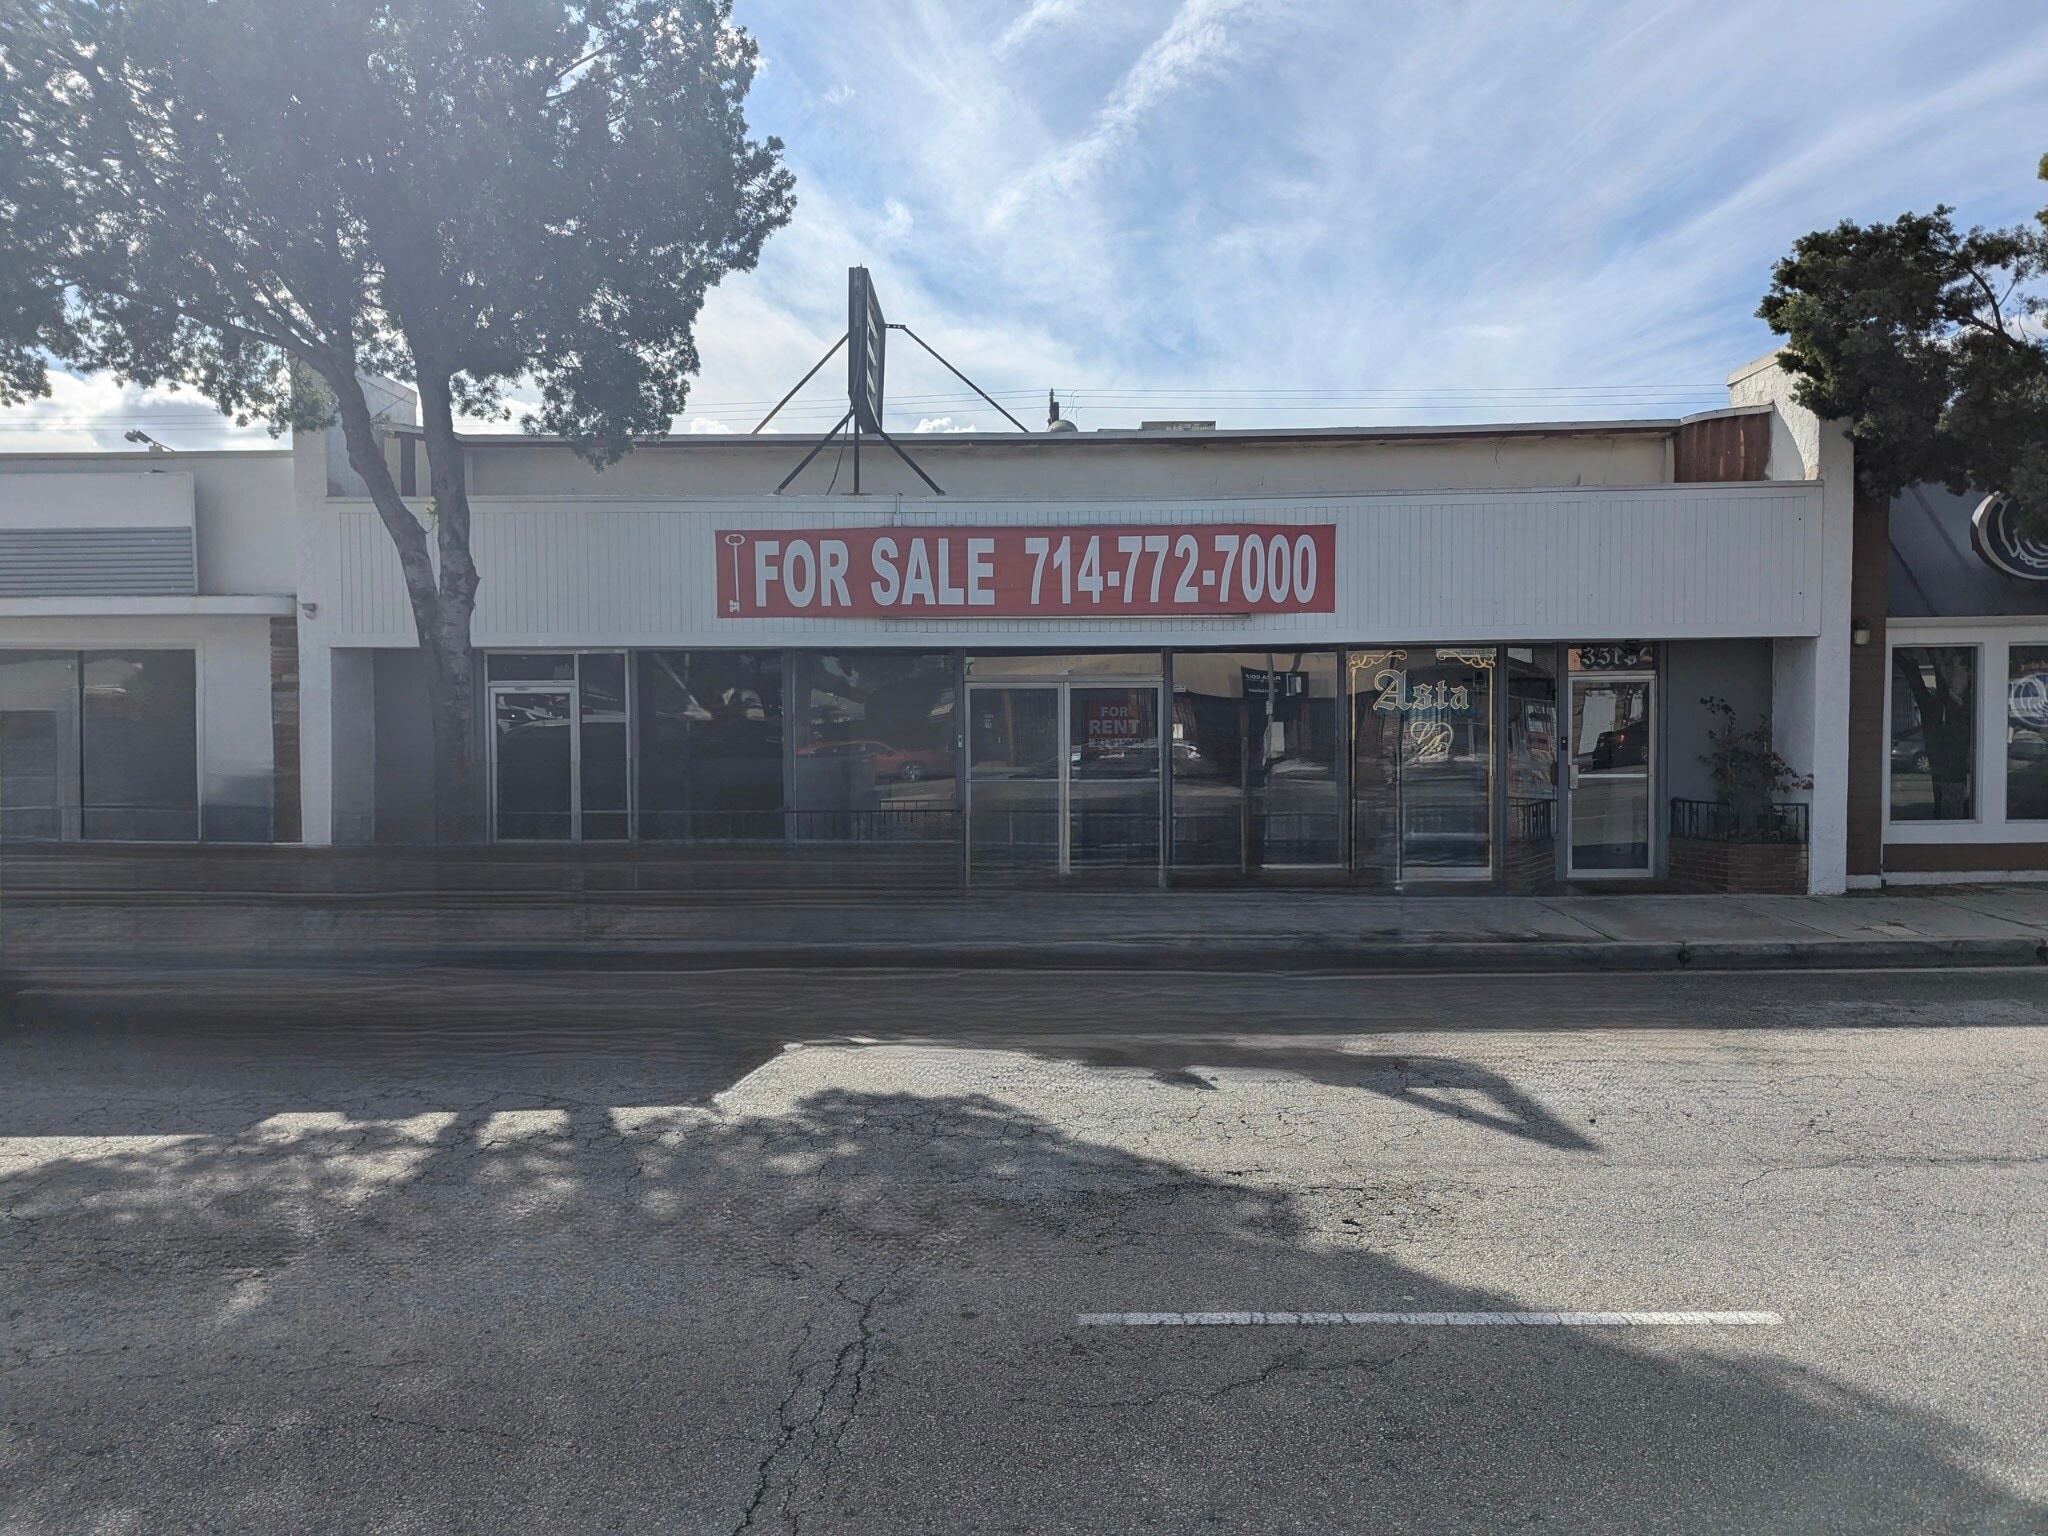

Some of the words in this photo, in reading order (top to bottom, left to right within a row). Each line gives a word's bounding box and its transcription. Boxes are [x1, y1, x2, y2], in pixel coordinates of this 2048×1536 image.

[755, 539, 851, 608] FOR
[871, 537, 995, 606] SALE
[1025, 533, 1317, 605] 714-772-7000
[1372, 669, 1470, 710] Asta
[1101, 706, 1128, 717] FOR
[1088, 719, 1140, 735] RENT
